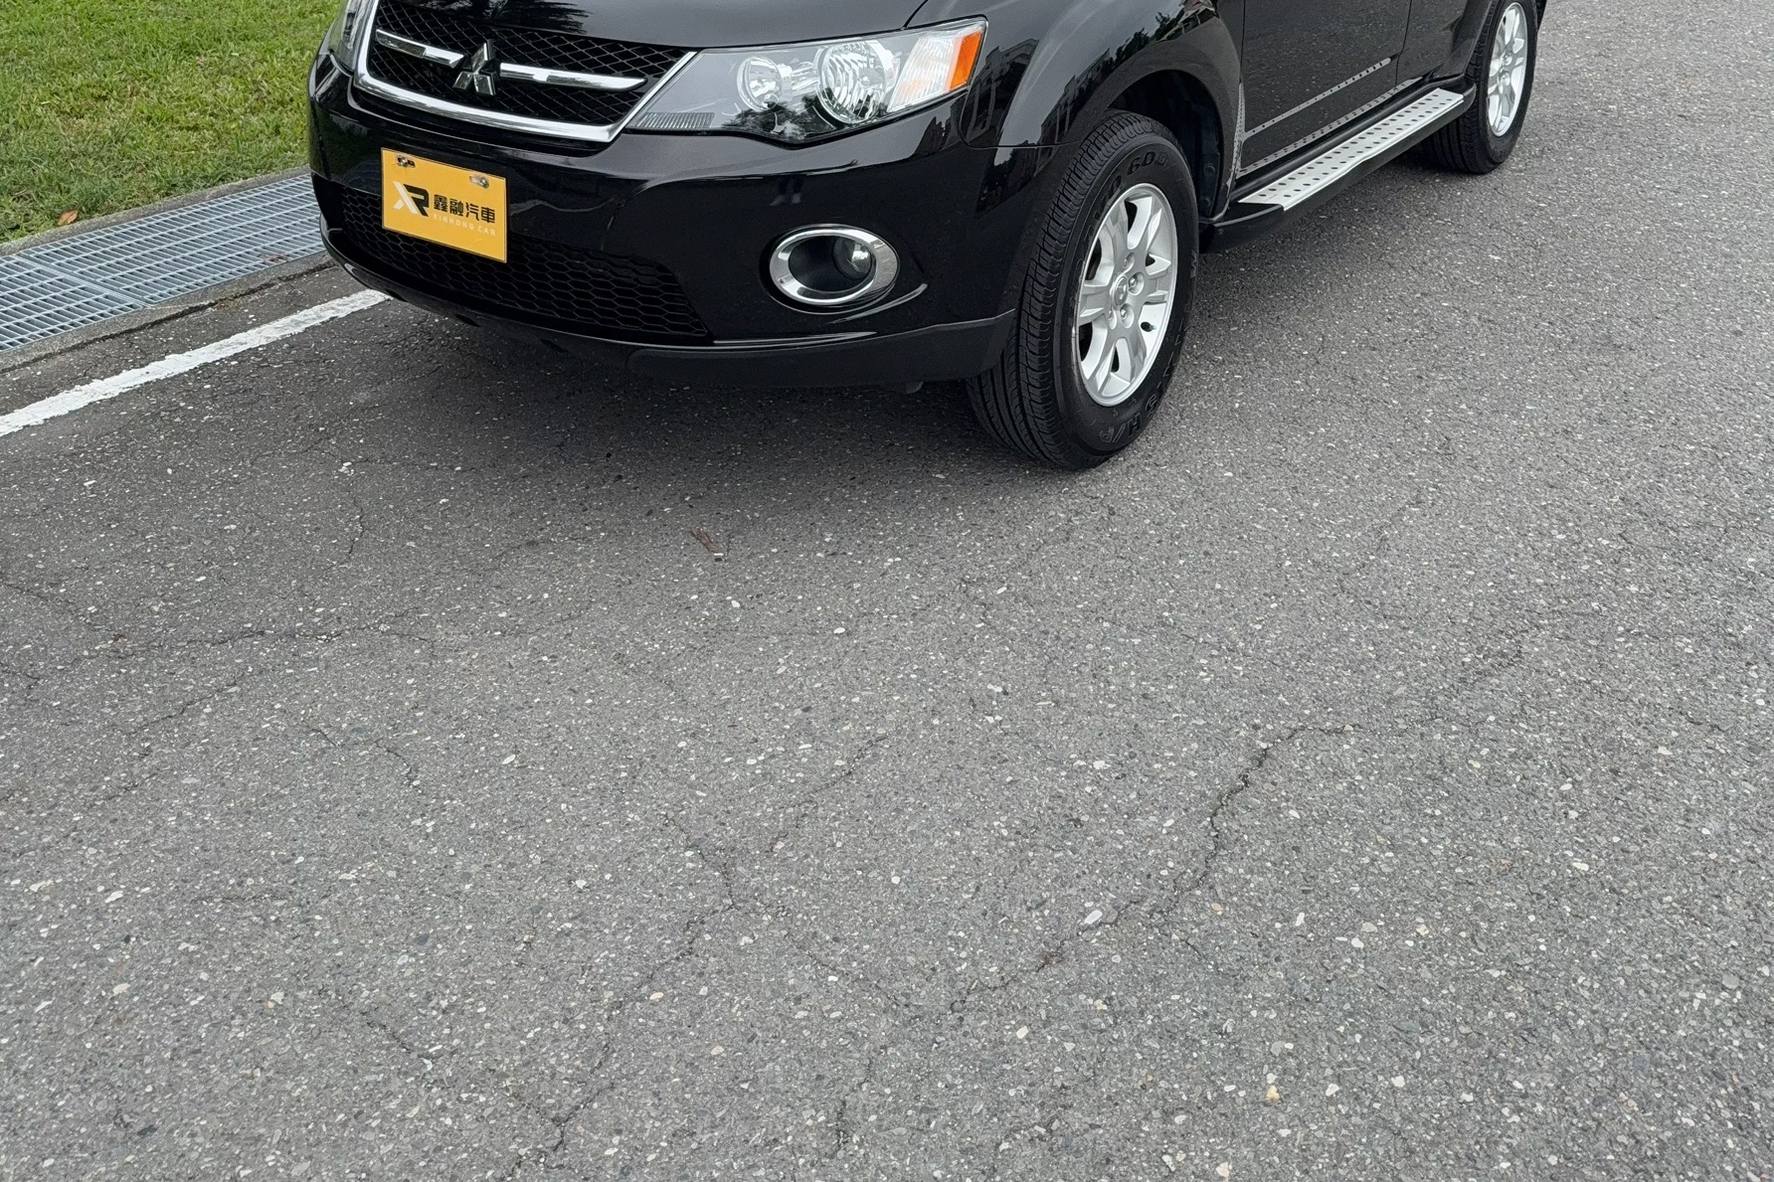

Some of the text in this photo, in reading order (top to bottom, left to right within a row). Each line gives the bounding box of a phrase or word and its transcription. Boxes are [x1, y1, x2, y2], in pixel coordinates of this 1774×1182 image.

[433, 194, 496, 224] 鑫融汽車
[433, 213, 496, 237] XINRONG CAR
